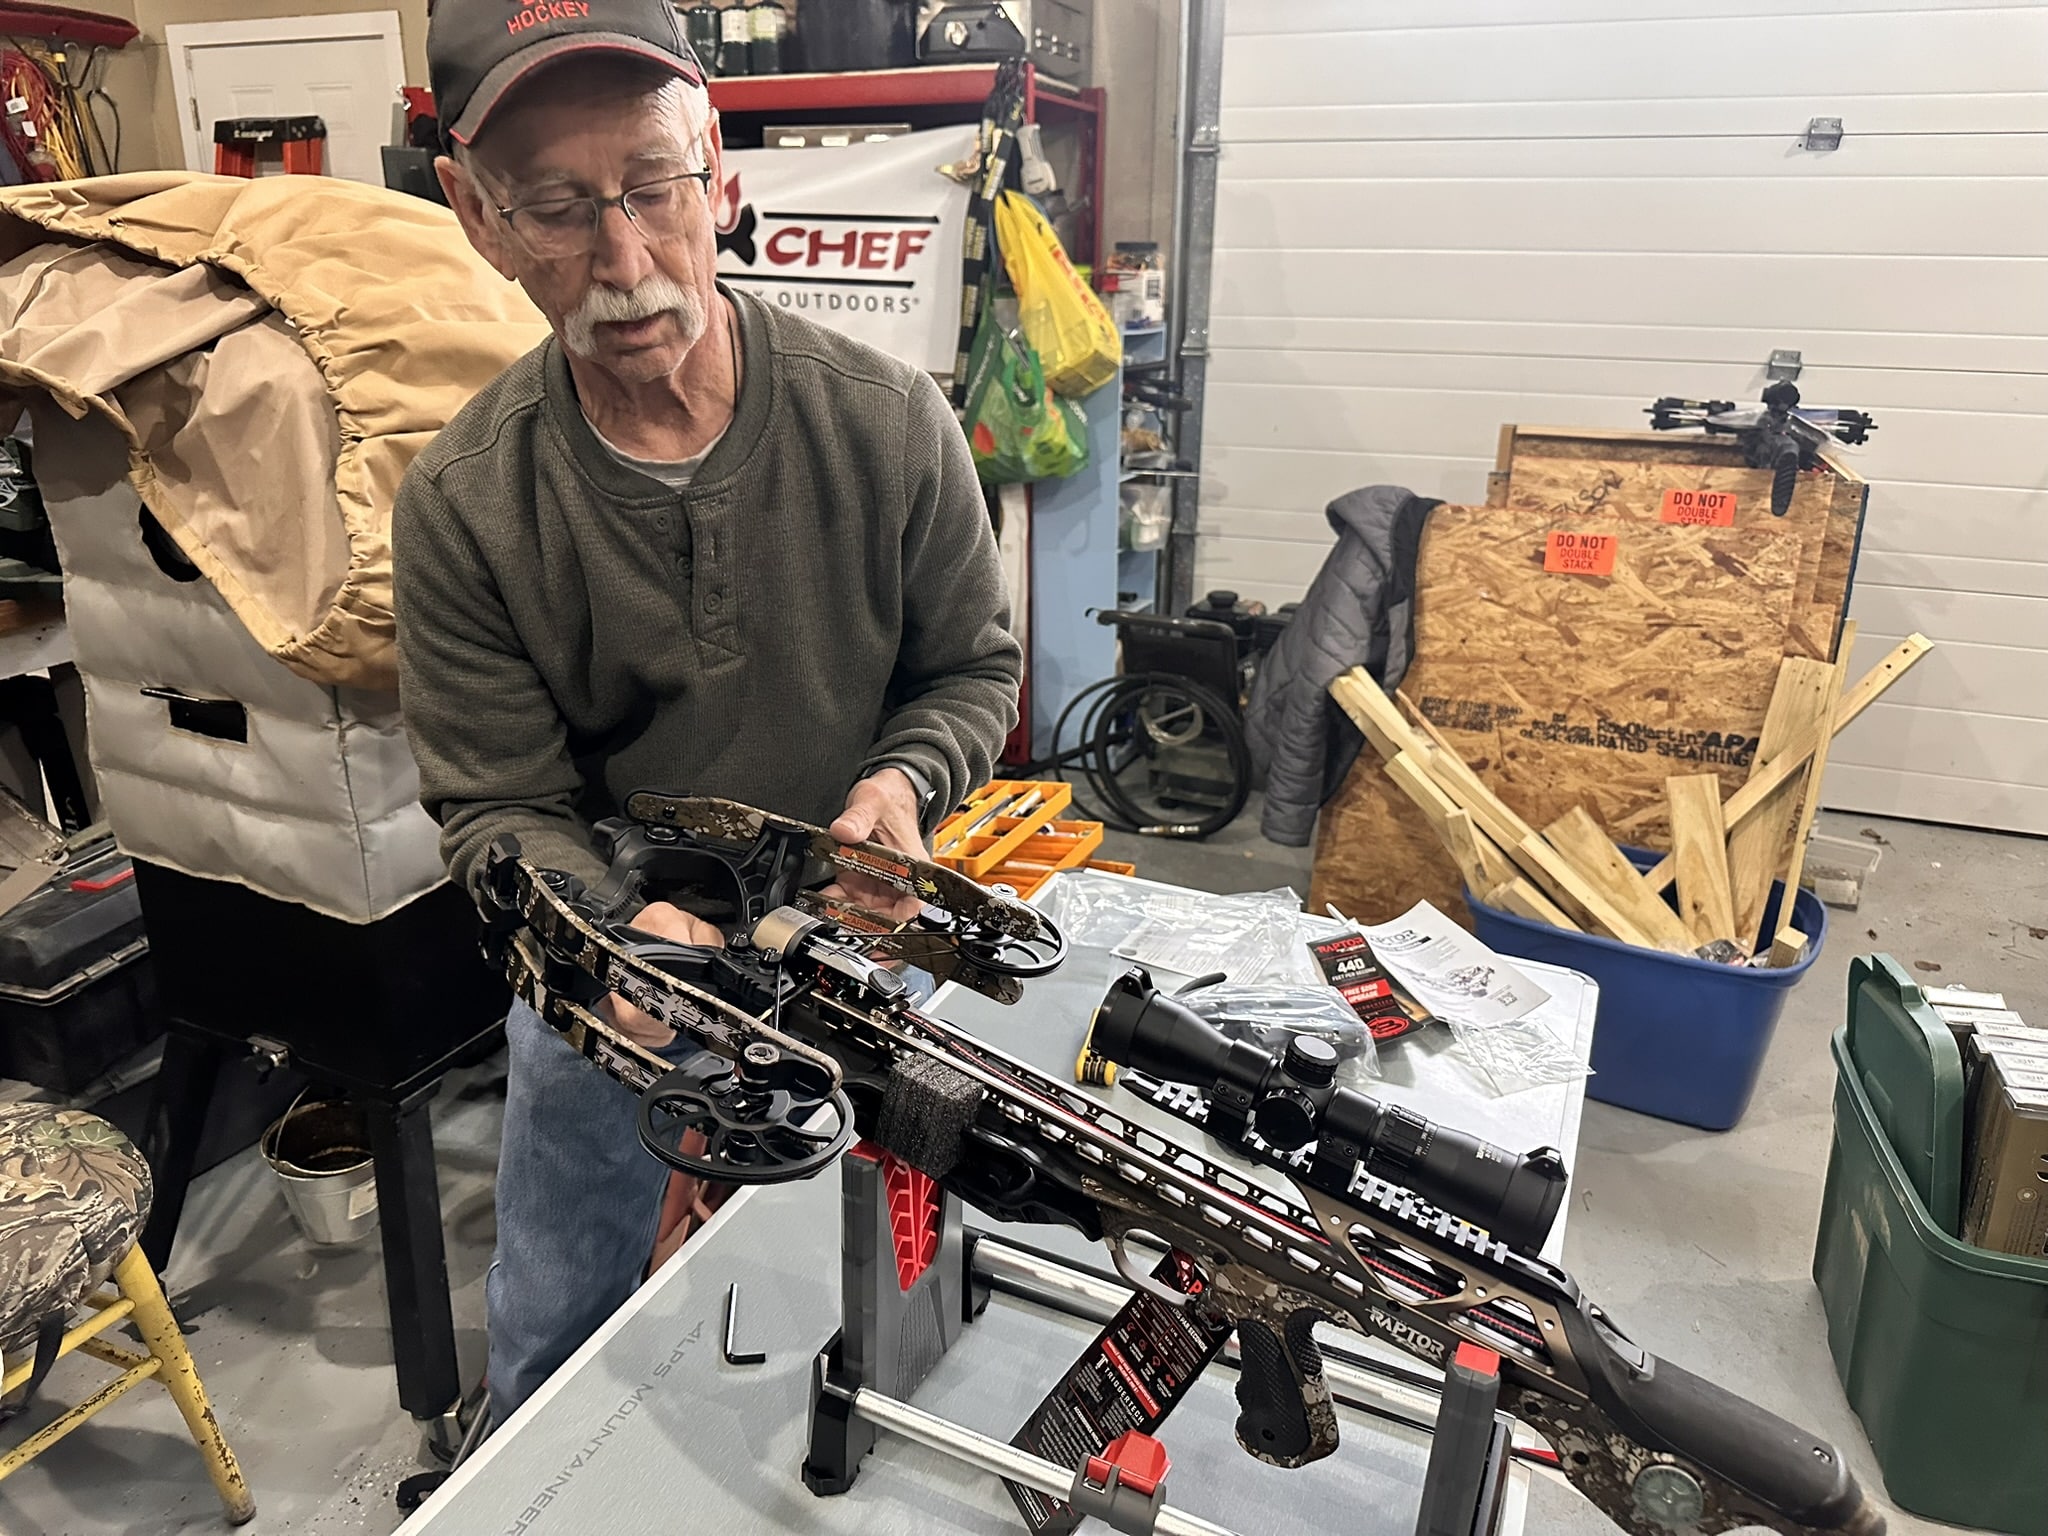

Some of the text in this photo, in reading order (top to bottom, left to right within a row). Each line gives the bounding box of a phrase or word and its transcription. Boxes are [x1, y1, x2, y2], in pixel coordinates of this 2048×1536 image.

[506, 1, 589, 35] HOCKEY
[765, 227, 932, 271] CHEF
[1674, 492, 1727, 508] DO NOT
[1677, 507, 1718, 518] DOUBLE
[1556, 534, 1607, 549] DO NOT
[1560, 548, 1600, 561] DOUBLE
[1562, 559, 1594, 570] STACK
[1597, 734, 1750, 767] RATED SHEATHING
[857, 852, 898, 873] WARNING
[1316, 936, 1365, 953] RAPTOR
[1337, 957, 1366, 974] 440
[1179, 1316, 1190, 1329] PAR
[1186, 1327, 1208, 1352] SECONDE
[1367, 1306, 1445, 1359] RAPTOR
[652, 1320, 705, 1378] ALPS
[507, 1383, 654, 1536] MOUNTAINEER
